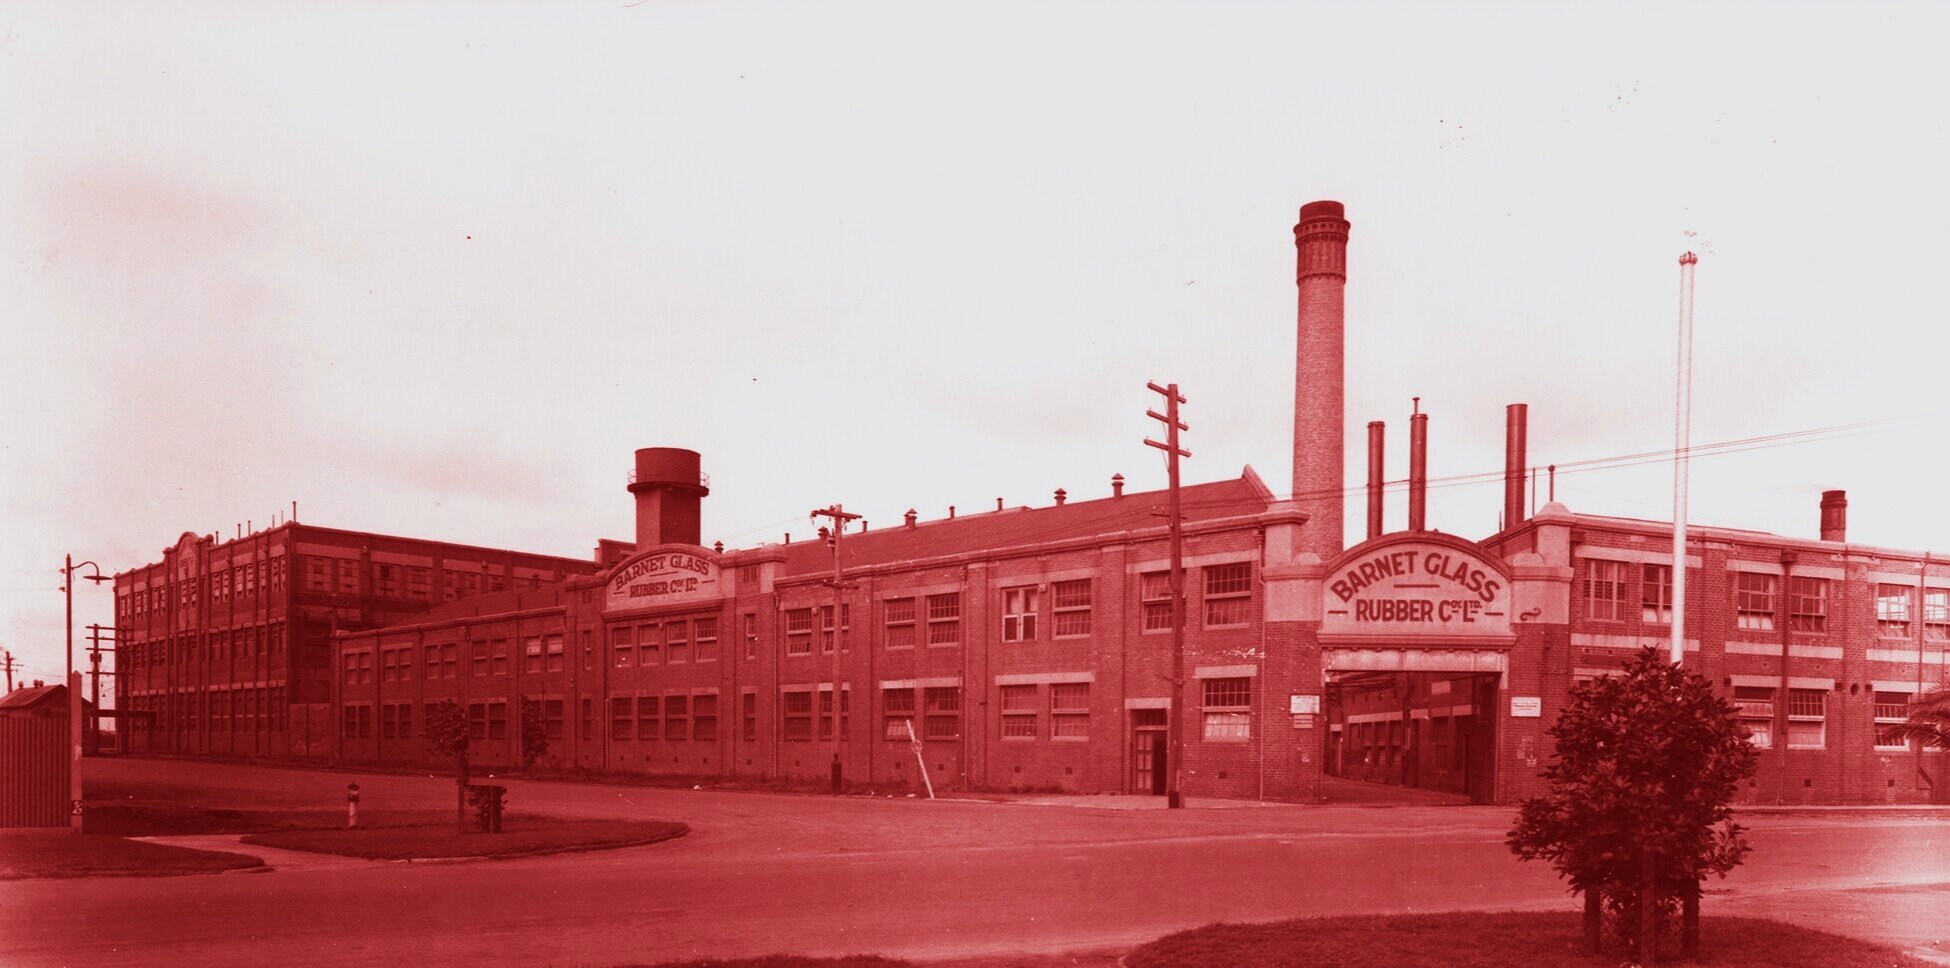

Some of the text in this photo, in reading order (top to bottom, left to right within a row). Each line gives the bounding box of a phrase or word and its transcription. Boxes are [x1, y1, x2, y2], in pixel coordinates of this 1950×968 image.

[615, 555, 710, 590] BARNET GLASS
[1330, 551, 1500, 603] BARNET GLASS
[629, 581, 668, 598] RUBBER
[1356, 599, 1433, 622] RUBBER
